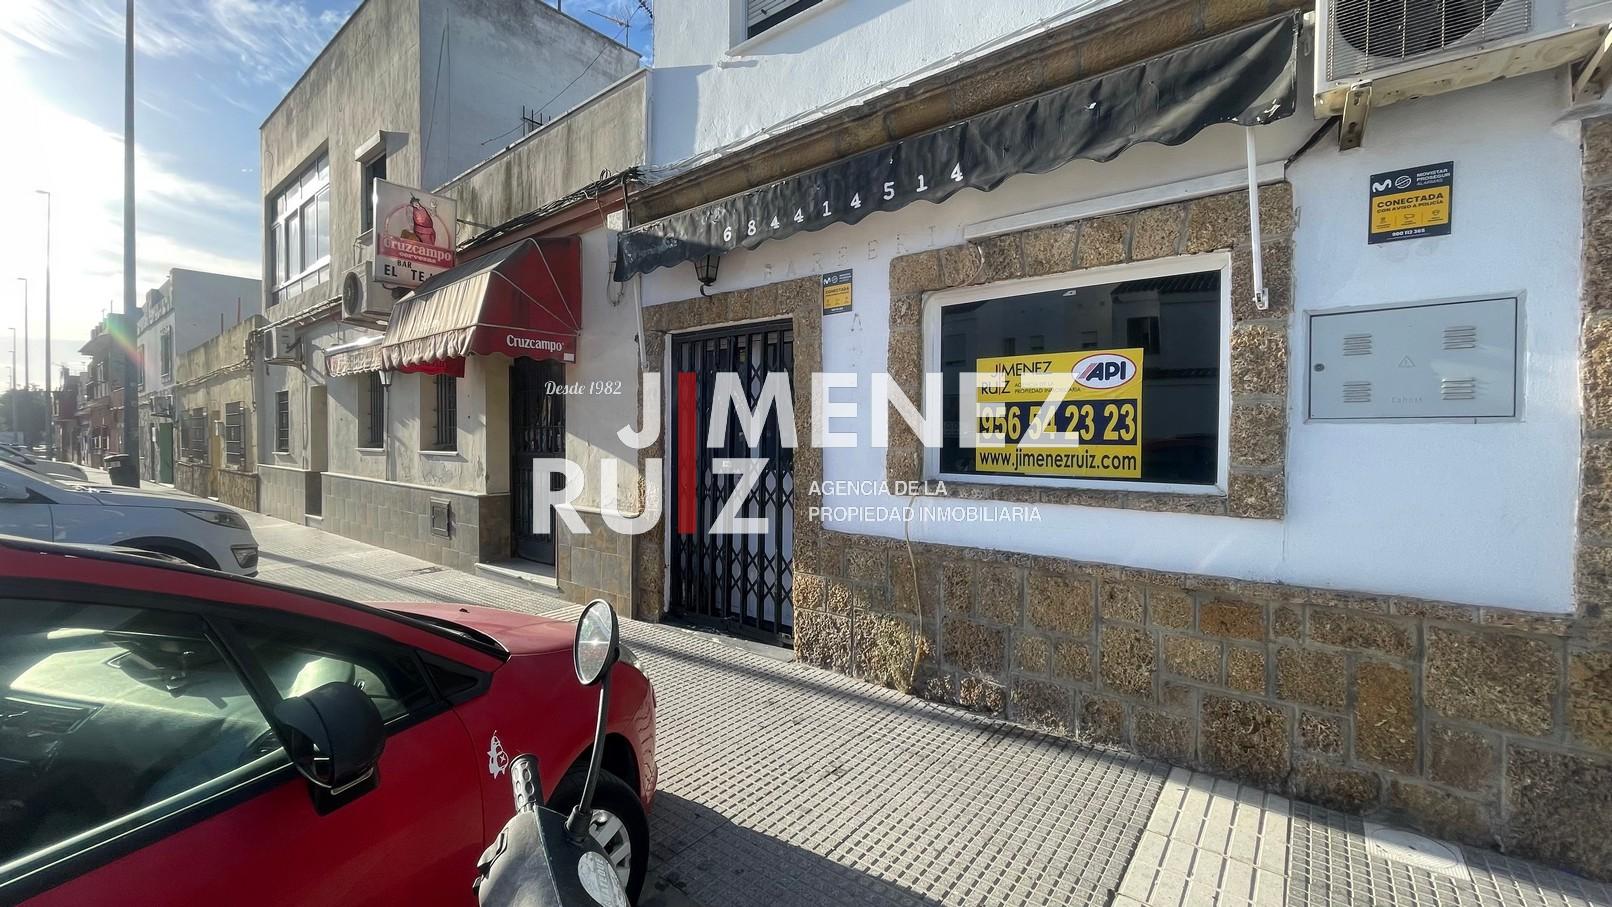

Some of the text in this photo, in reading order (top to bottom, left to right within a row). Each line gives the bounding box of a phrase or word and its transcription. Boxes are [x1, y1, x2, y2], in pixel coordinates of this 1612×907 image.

[1377, 192, 1444, 208] CONECTADA
[383, 237, 452, 262] Cruzcampo
[384, 264, 398, 278] EL
[397, 260, 412, 269] BAR
[507, 334, 563, 352] Cruzcampo
[1087, 361, 1127, 382] API
[981, 403, 1136, 441] 956 54 23 23
[980, 449, 1137, 472] www.jimenezruiz.com
